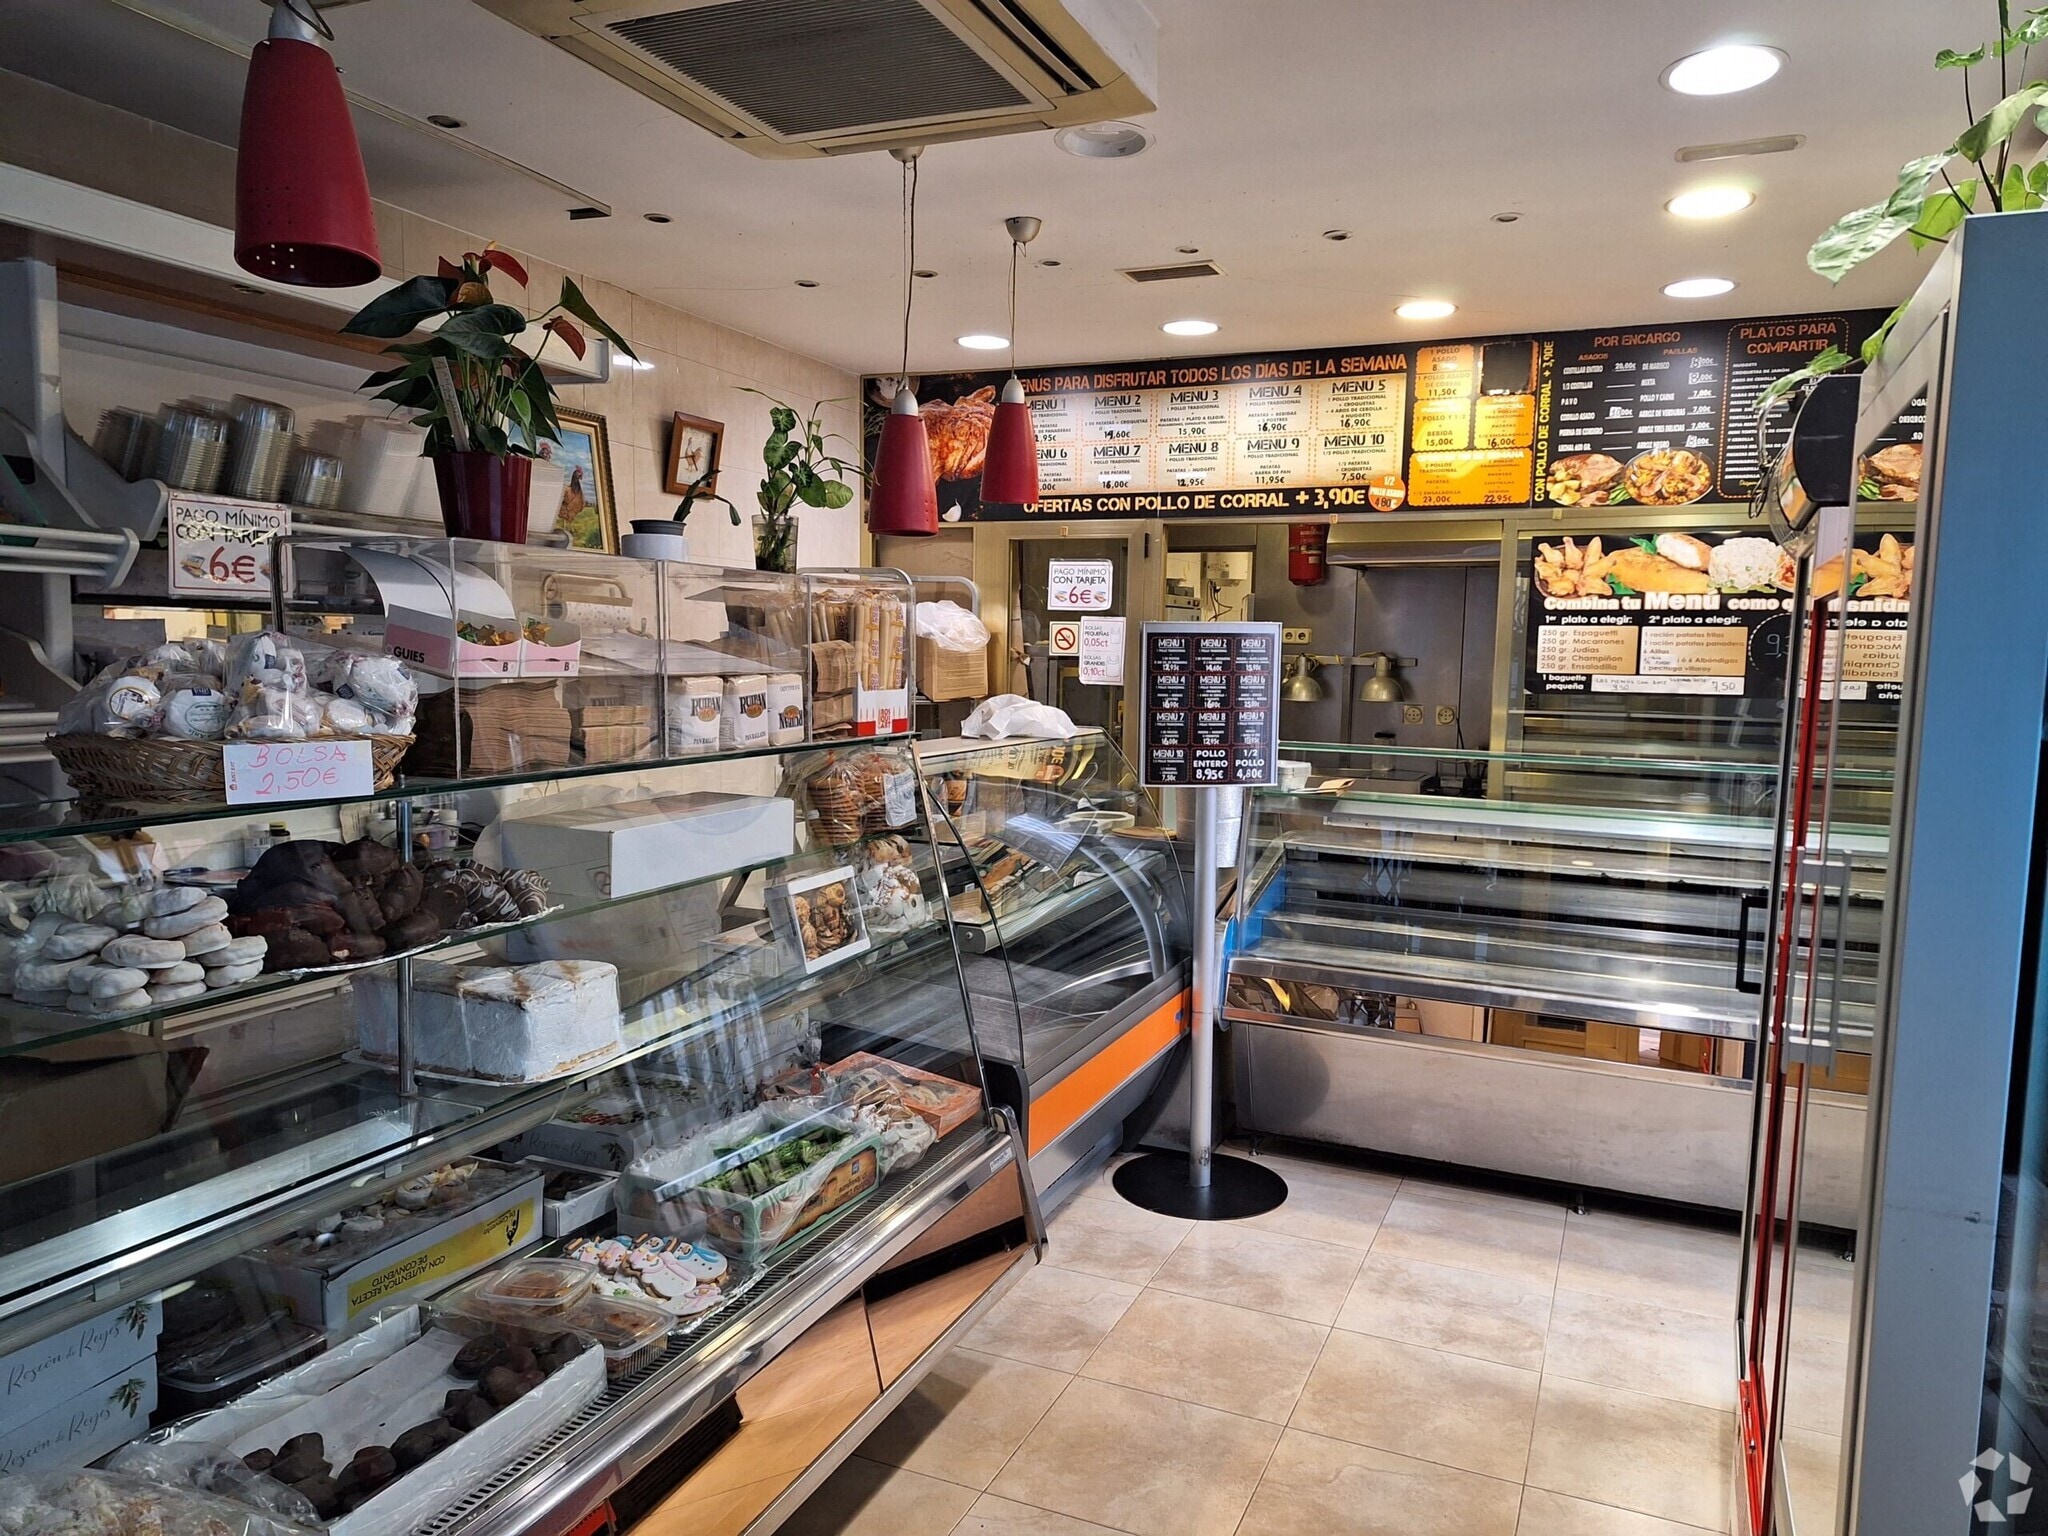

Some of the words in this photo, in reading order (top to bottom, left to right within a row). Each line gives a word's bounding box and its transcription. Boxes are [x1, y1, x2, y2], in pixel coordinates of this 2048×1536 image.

[1740, 324, 1796, 339] PLATOS
[1799, 322, 1837, 336] PARA
[1594, 335, 1619, 347] POR
[1622, 331, 1681, 346] ENCARGO
[1663, 347, 1698, 355] PAELLAS
[1747, 338, 1829, 354] COMPARTIR
[1020, 371, 1051, 393] ENÚS
[1055, 374, 1090, 391] PARA
[1093, 370, 1166, 388] DISFRUTAR
[1171, 366, 1218, 384] TODOS
[1221, 364, 1251, 382] LOS
[1255, 357, 1289, 379] DÍAS
[1292, 361, 1312, 377] DE
[1315, 358, 1336, 374] LA
[1340, 353, 1407, 373] SEMANA
[1293, 384, 1302, 396] 4
[1378, 379, 1386, 391] 5
[1212, 389, 1219, 401] 3
[1428, 388, 1457, 397] 11,50€
[1134, 394, 1141, 406] 2
[1539, 380, 1552, 424] CORRAL
[1257, 423, 1287, 432] 16,90€
[1340, 418, 1371, 428] 16,90€
[1178, 427, 1206, 436] 15,90€
[1538, 425, 1549, 439] DE
[1291, 437, 1300, 449] 9
[1370, 433, 1385, 445] 10
[1426, 438, 1454, 447] 15,00€
[1487, 438, 1516, 448] 16,00€
[1060, 447, 1067, 459] 6
[1133, 445, 1141, 456] 7
[1211, 441, 1219, 453] 8
[1536, 440, 1548, 477] POLLO
[1255, 475, 1285, 484] 11,95€
[1341, 472, 1367, 481] 7,50€
[1102, 480, 1129, 490] 16,00€
[1176, 478, 1205, 488] 12,95€
[1534, 478, 1545, 502] CON
[1022, 498, 1092, 513] OFERTAS
[1096, 496, 1130, 512] CON
[1135, 495, 1189, 511] POLLO
[1194, 494, 1215, 509] DE
[1220, 492, 1289, 508] CORRAL
[176, 507, 219, 523] PAGO
[225, 509, 280, 529] MÍNIMO
[175, 523, 215, 541] CON
[209, 546, 256, 583] 6€
[1077, 567, 1107, 575] MÍNIMO
[1053, 576, 1073, 584] CON
[1075, 576, 1107, 586] TARJETA
[1068, 585, 1092, 604] 6€
[1544, 596, 1620, 610] Combina
[1621, 597, 1642, 610] tu
[1644, 588, 1721, 610] Menú
[1727, 598, 1780, 611] como
[1561, 615, 1588, 625] plato
[1590, 616, 1598, 624] a
[1600, 615, 1633, 626] elegir:
[1662, 615, 1692, 626] plato
[1694, 616, 1703, 624] a
[1705, 615, 1742, 626] elegir:
[1084, 637, 1108, 647] 0,05ct
[393, 646, 425, 663] GUIES
[1082, 667, 1106, 677] 0,10ct
[1549, 674, 1586, 683] baguette
[1546, 682, 1584, 691] pequeña
[248, 745, 346, 768] BOLSA
[1235, 759, 1264, 767] POLLO
[1196, 769, 1224, 779] 8,95€
[1237, 769, 1262, 778] 4,80€
[255, 767, 340, 795] 2,50€
[417, 1254, 428, 1266] DE
[428, 1255, 446, 1270] CON
[371, 1260, 417, 1288] CONVENTO
[384, 1263, 428, 1291] AUTENTICA
[351, 1285, 382, 1307] RECETA
